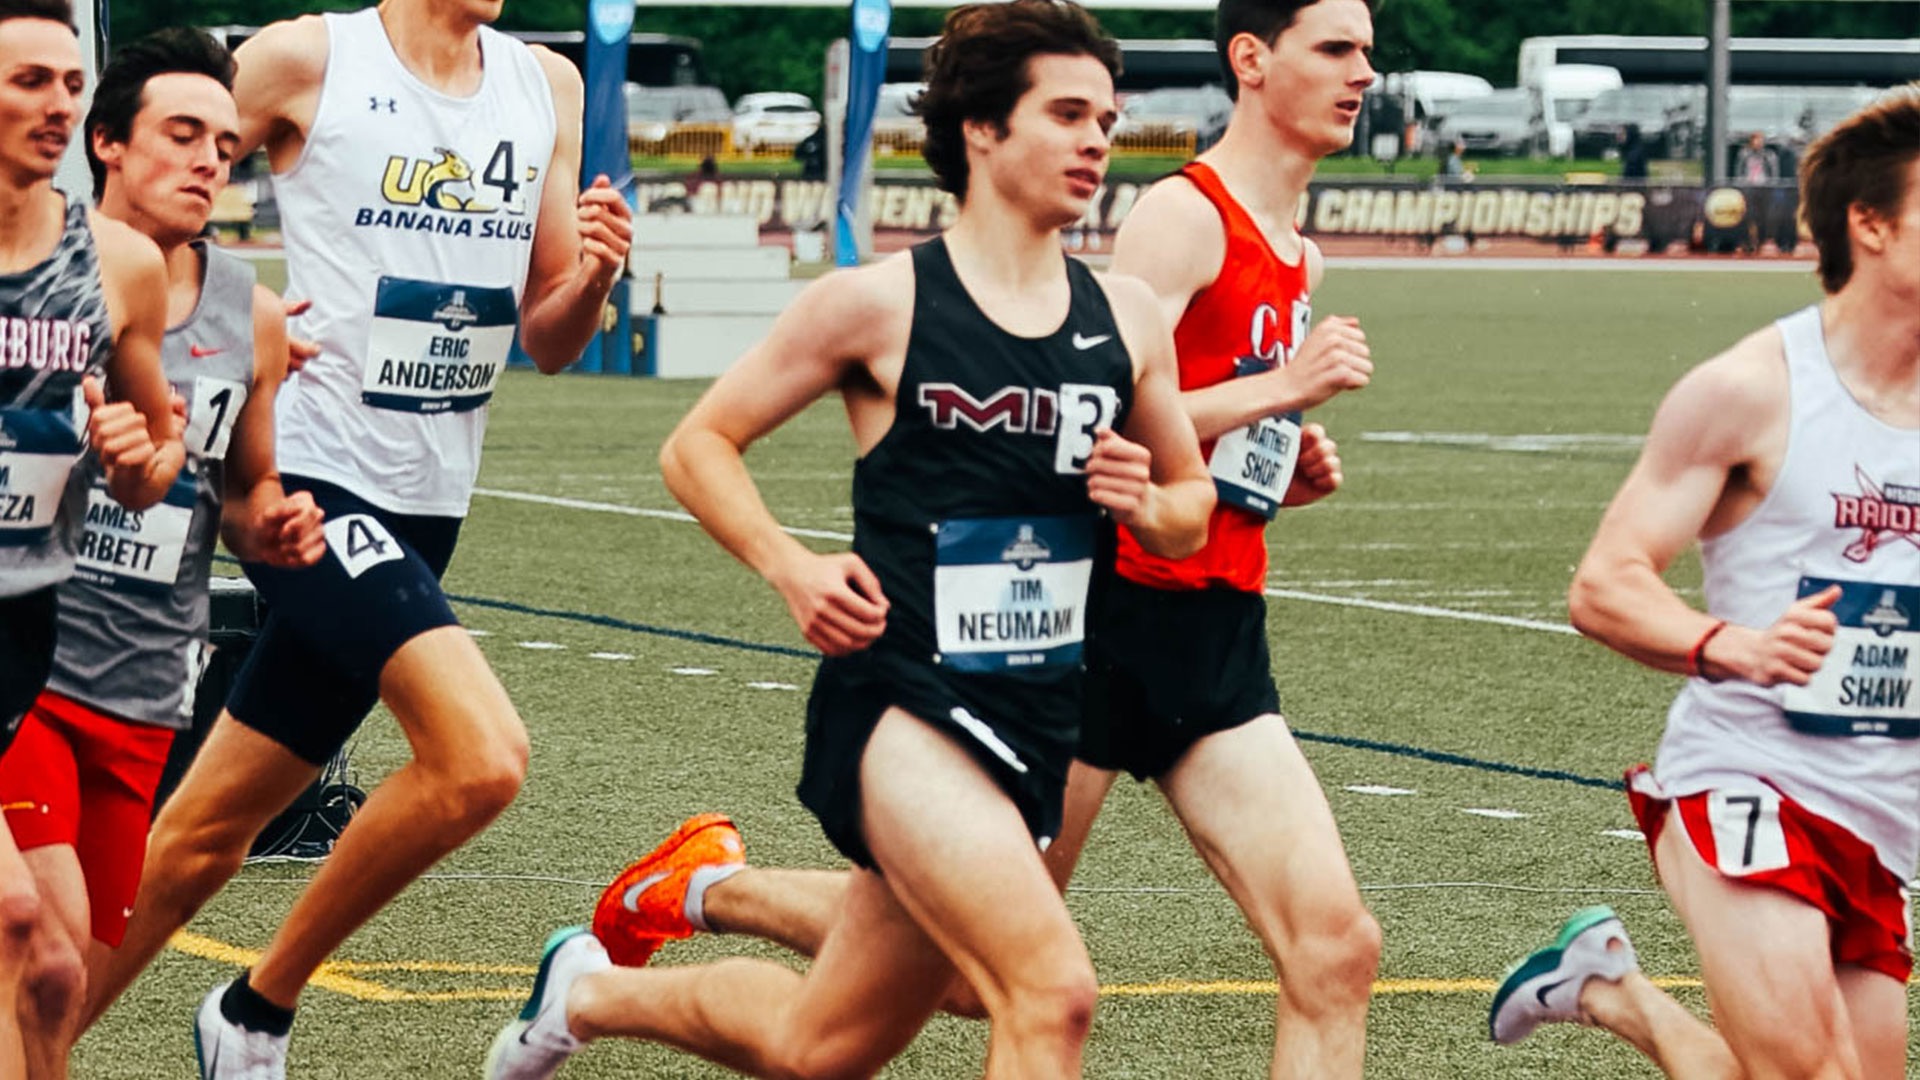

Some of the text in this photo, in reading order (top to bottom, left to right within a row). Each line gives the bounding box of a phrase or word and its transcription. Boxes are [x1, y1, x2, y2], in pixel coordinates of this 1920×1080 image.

[483, 141, 519, 203] 4
[355, 207, 472, 237] BANANA
[1315, 189, 1645, 236] CHAMPIONSHIPS
[429, 336, 470, 358] ERIC
[378, 359, 496, 391] ANDERSON
[209, 387, 232, 452] 1
[1070, 393, 1103, 470] 3
[347, 518, 387, 559] 4
[1011, 579, 1043, 602] TIM
[1852, 644, 1908, 670] ADAM
[1839, 675, 1911, 709] SHAW
[1726, 796, 1761, 867] 7
